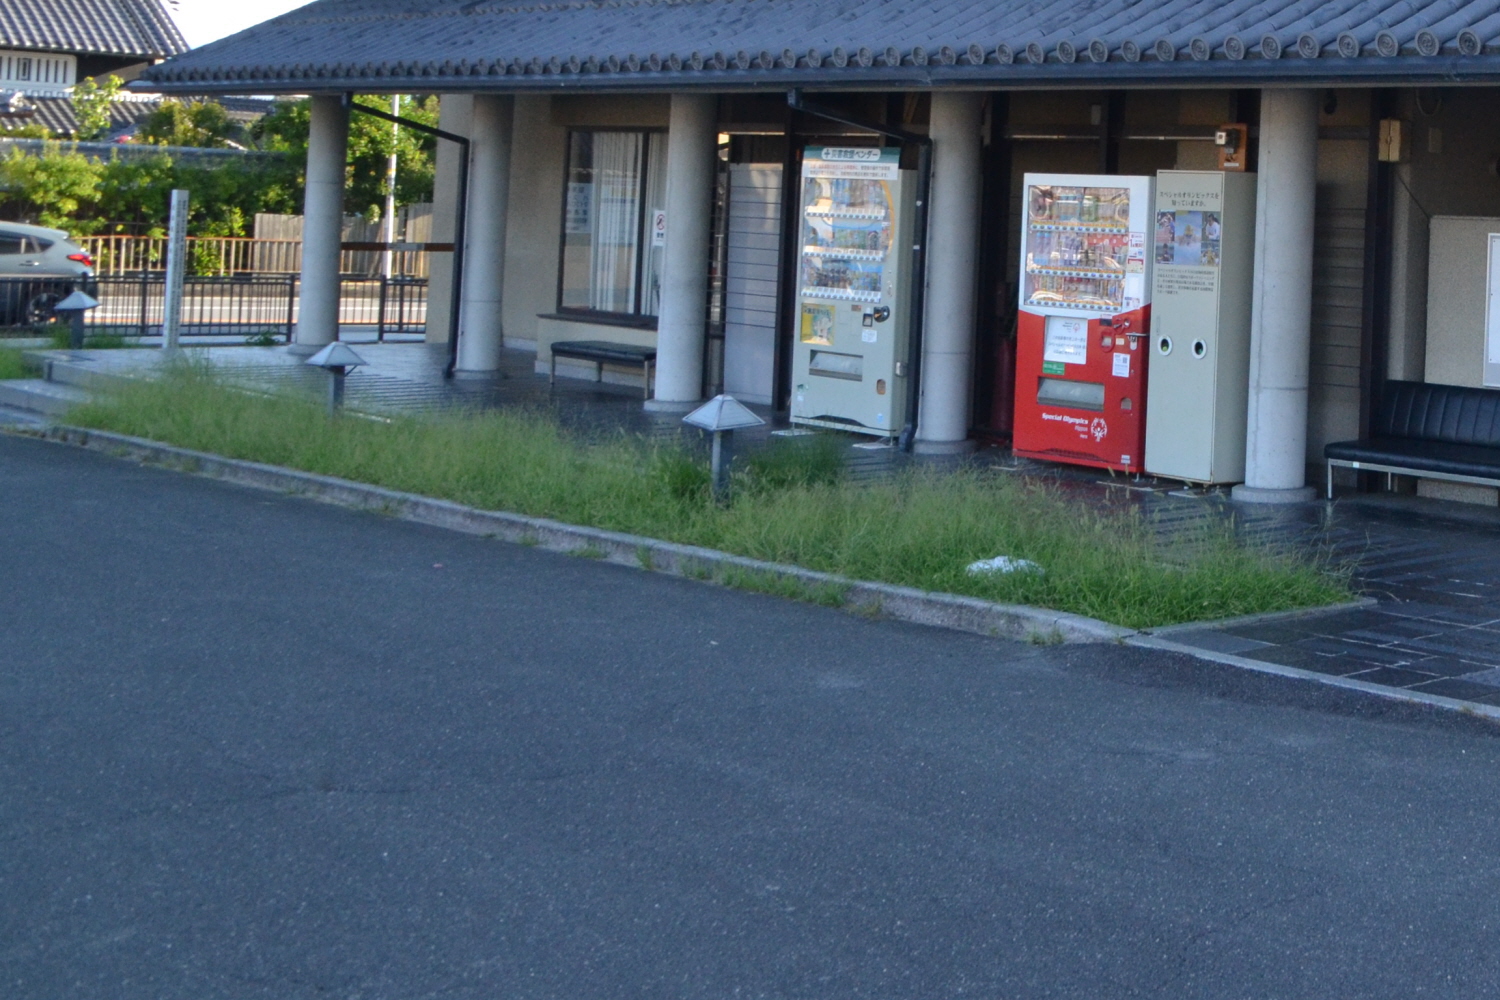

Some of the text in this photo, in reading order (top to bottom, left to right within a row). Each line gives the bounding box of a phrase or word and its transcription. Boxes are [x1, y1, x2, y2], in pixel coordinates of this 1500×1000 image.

[1159, 191, 1220, 200] スペシャルオリンピックスを
[1041, 412, 1089, 425] Special Olympics
